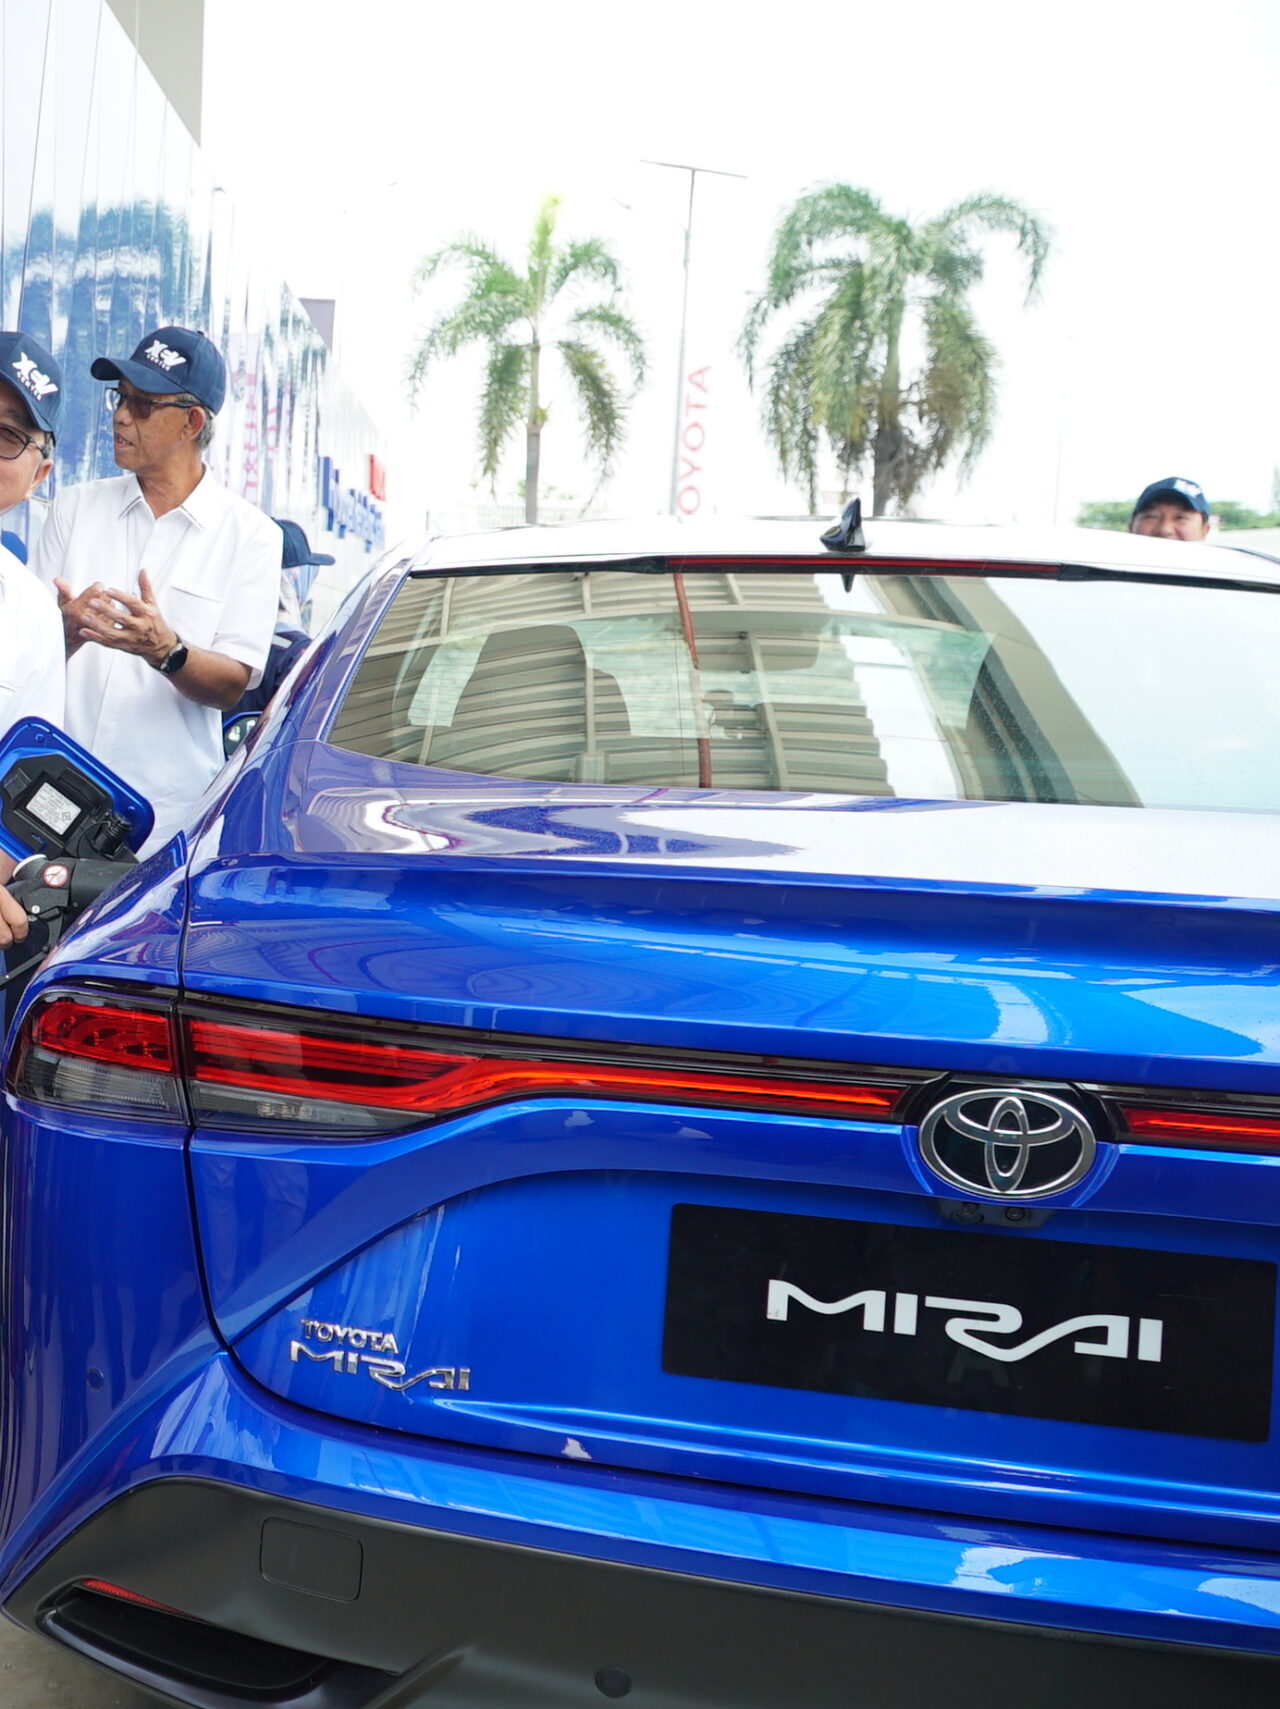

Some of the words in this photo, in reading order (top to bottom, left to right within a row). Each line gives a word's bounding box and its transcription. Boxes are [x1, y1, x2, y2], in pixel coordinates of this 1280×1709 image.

[677, 365, 711, 515] OYOTA
[300, 1318, 399, 1354] TOYOTA
[766, 1279, 1164, 1363] MIRAI
[289, 1340, 471, 1391] MIRAI
